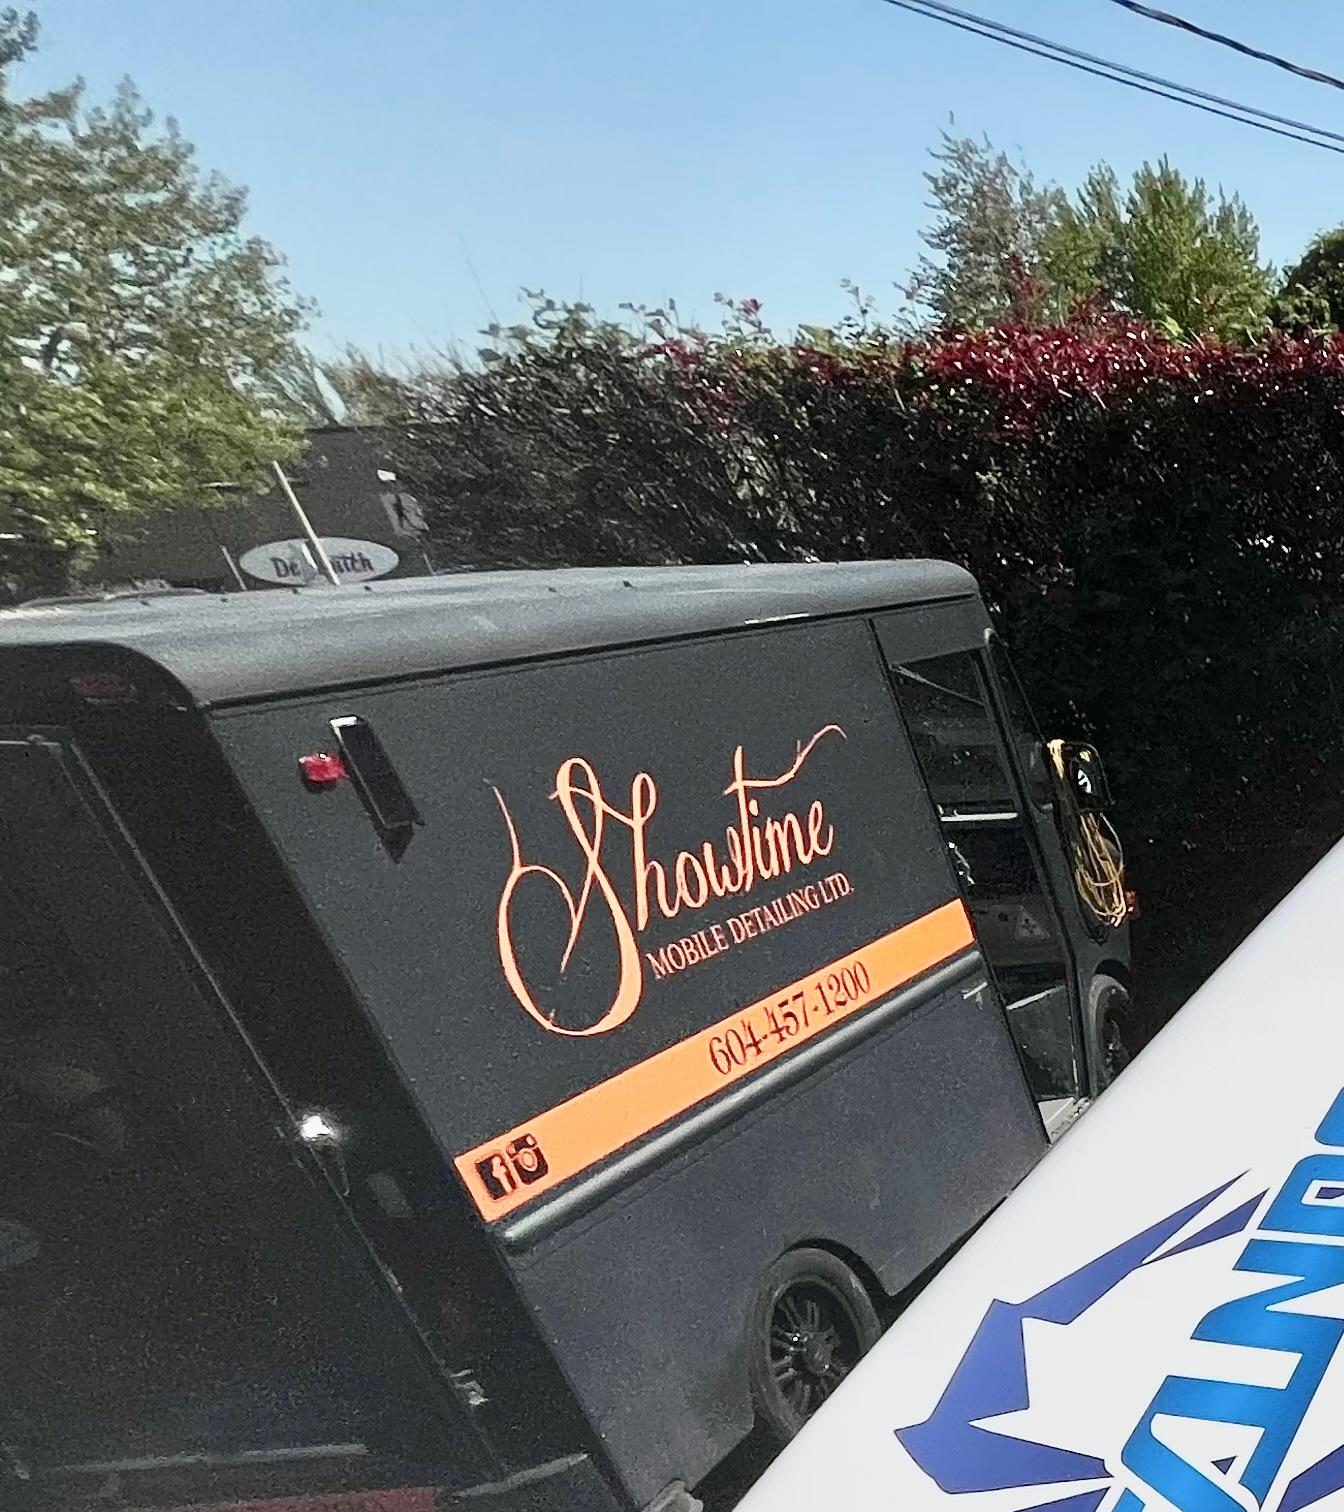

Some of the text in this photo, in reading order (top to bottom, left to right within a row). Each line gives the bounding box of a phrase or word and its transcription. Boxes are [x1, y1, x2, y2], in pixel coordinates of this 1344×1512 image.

[269, 556, 299, 578] De
[483, 724, 848, 1037] Showtime
[645, 872, 856, 980] MOBILE DETAILING LTD.
[707, 959, 872, 1076] 604-457-1200
